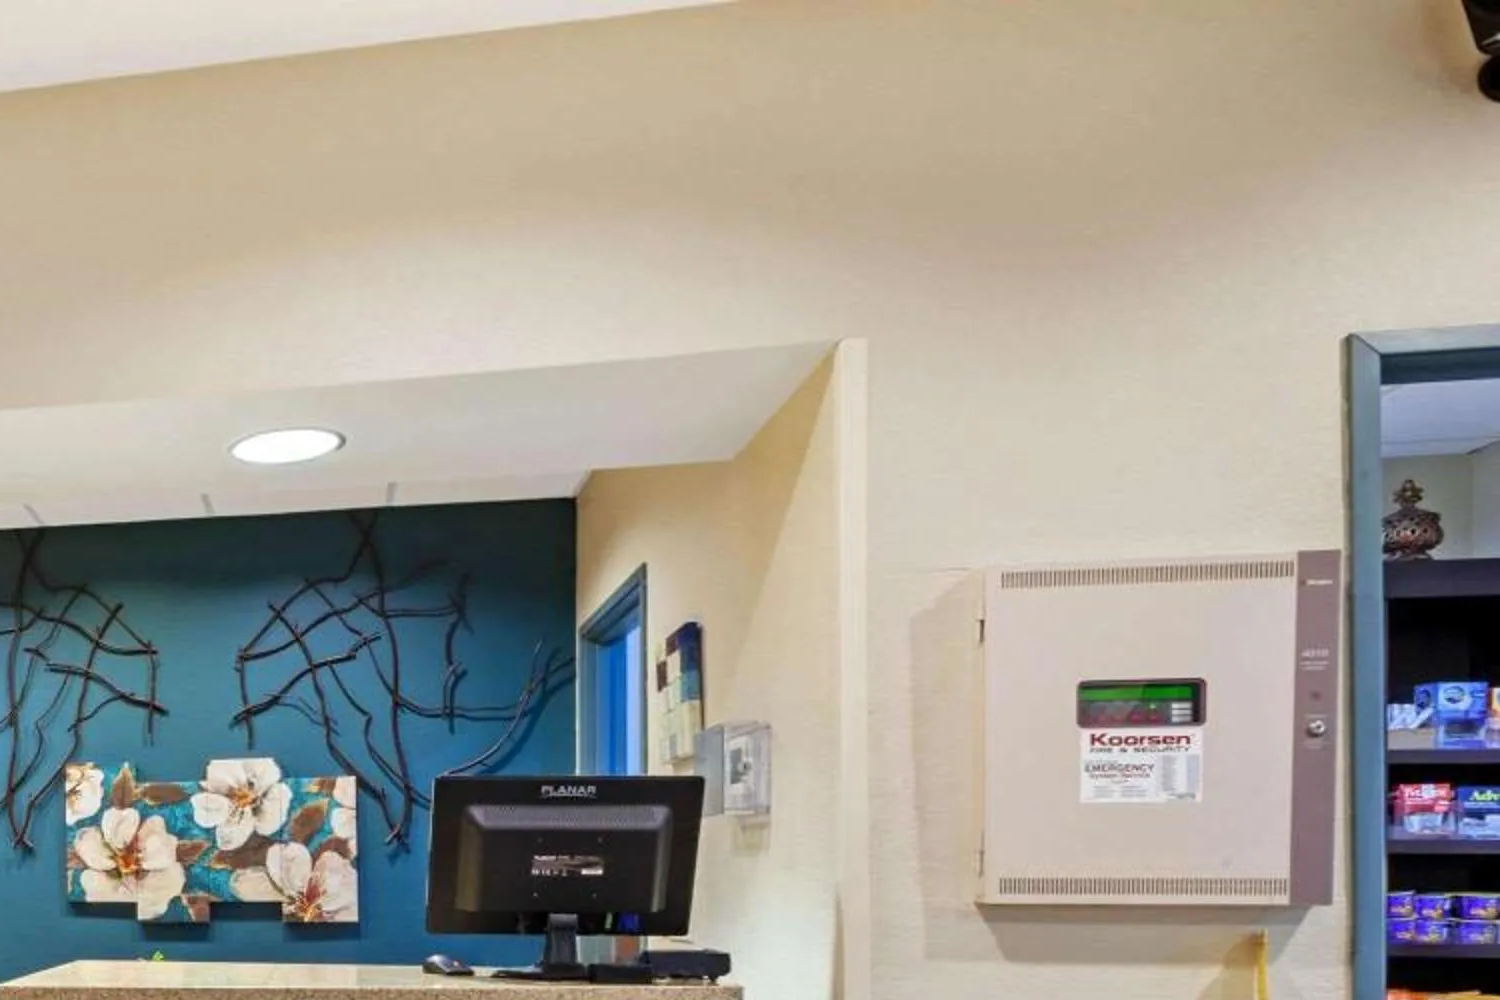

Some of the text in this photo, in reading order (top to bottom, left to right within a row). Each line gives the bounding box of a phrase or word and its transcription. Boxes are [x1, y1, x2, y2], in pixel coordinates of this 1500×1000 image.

[1090, 733, 1192, 747] Koorsen
[1084, 763, 1155, 773] EMERGENCY
[541, 785, 597, 794] PLANAR
